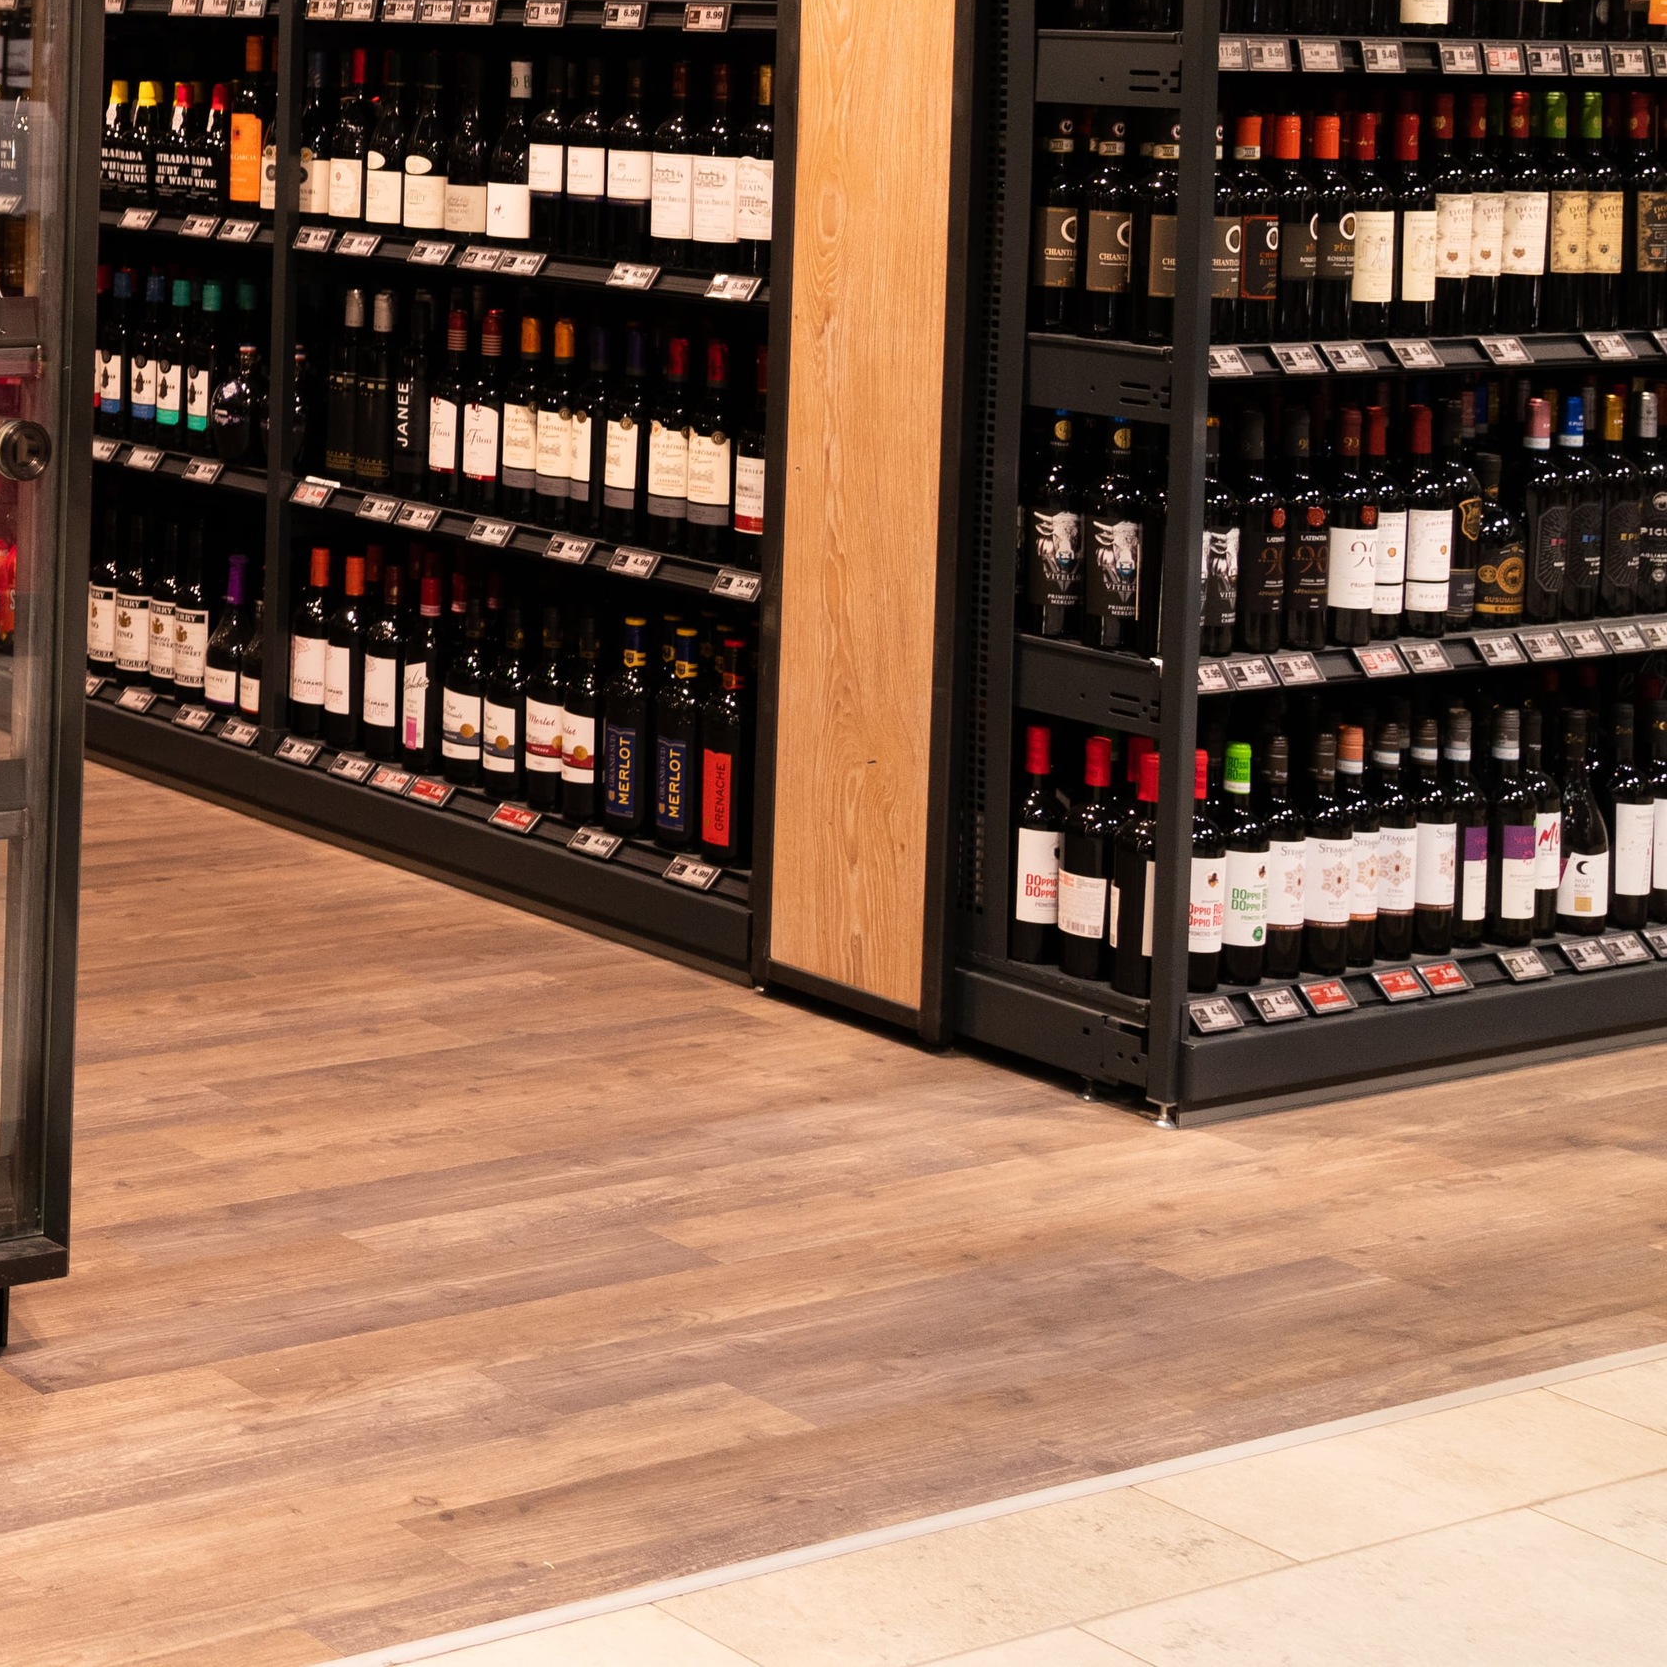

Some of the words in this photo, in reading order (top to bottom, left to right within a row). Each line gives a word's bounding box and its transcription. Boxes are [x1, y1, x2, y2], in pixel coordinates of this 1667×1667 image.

[623, 8, 640, 18] 6.99
[705, 10, 723, 21] 8.99
[1219, 46, 1241, 57] 11.99
[1267, 47, 1284, 58] 8.99
[1381, 49, 1398, 60] 9.49
[1044, 247, 1073, 257] CHIANTI
[1098, 252, 1128, 262] CHIANTI
[567, 543, 585, 554] 4.99
[632, 557, 650, 568] 4.99
[1045, 572, 1082, 581] VITELLO
[736, 579, 755, 590] 3.49
[1494, 605, 1523, 613] EPICU
[1246, 664, 1266, 676] 5.99
[1294, 660, 1312, 671] 5.99
[1203, 668, 1222, 680] 5.99
[527, 713, 555, 727] Merlot
[618, 736, 631, 805] MERLOT
[669, 748, 681, 818] MERLOT
[714, 763, 726, 832] GRENACHE
[690, 868, 710, 879] 4.99
[1232, 888, 1262, 901] DOPPIO
[1231, 899, 1262, 912] DOPPIO
